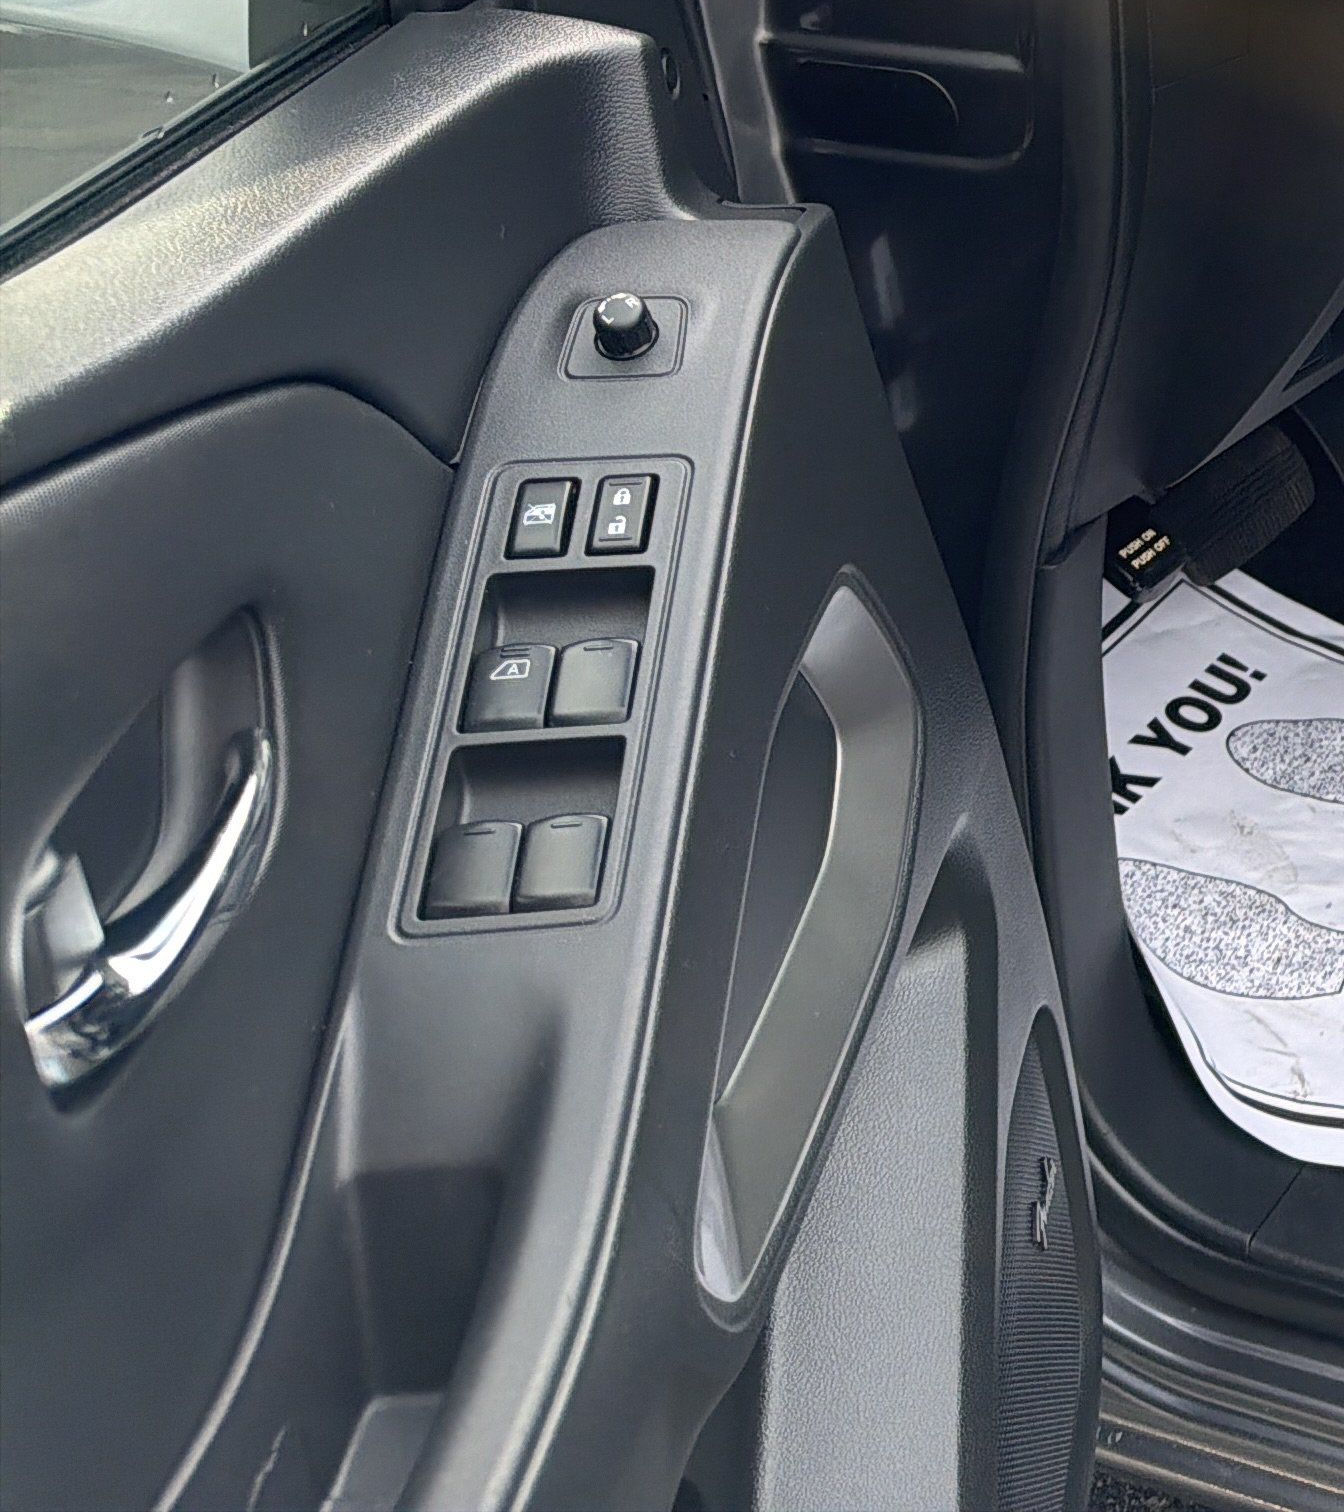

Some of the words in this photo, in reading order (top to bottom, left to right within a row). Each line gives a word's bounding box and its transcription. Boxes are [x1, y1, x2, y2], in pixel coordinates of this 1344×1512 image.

[625, 297, 639, 309] R
[601, 314, 615, 325] L
[1118, 537, 1145, 559] PUSH
[1130, 547, 1157, 570] PUSH
[1127, 652, 1268, 757] YOU!
